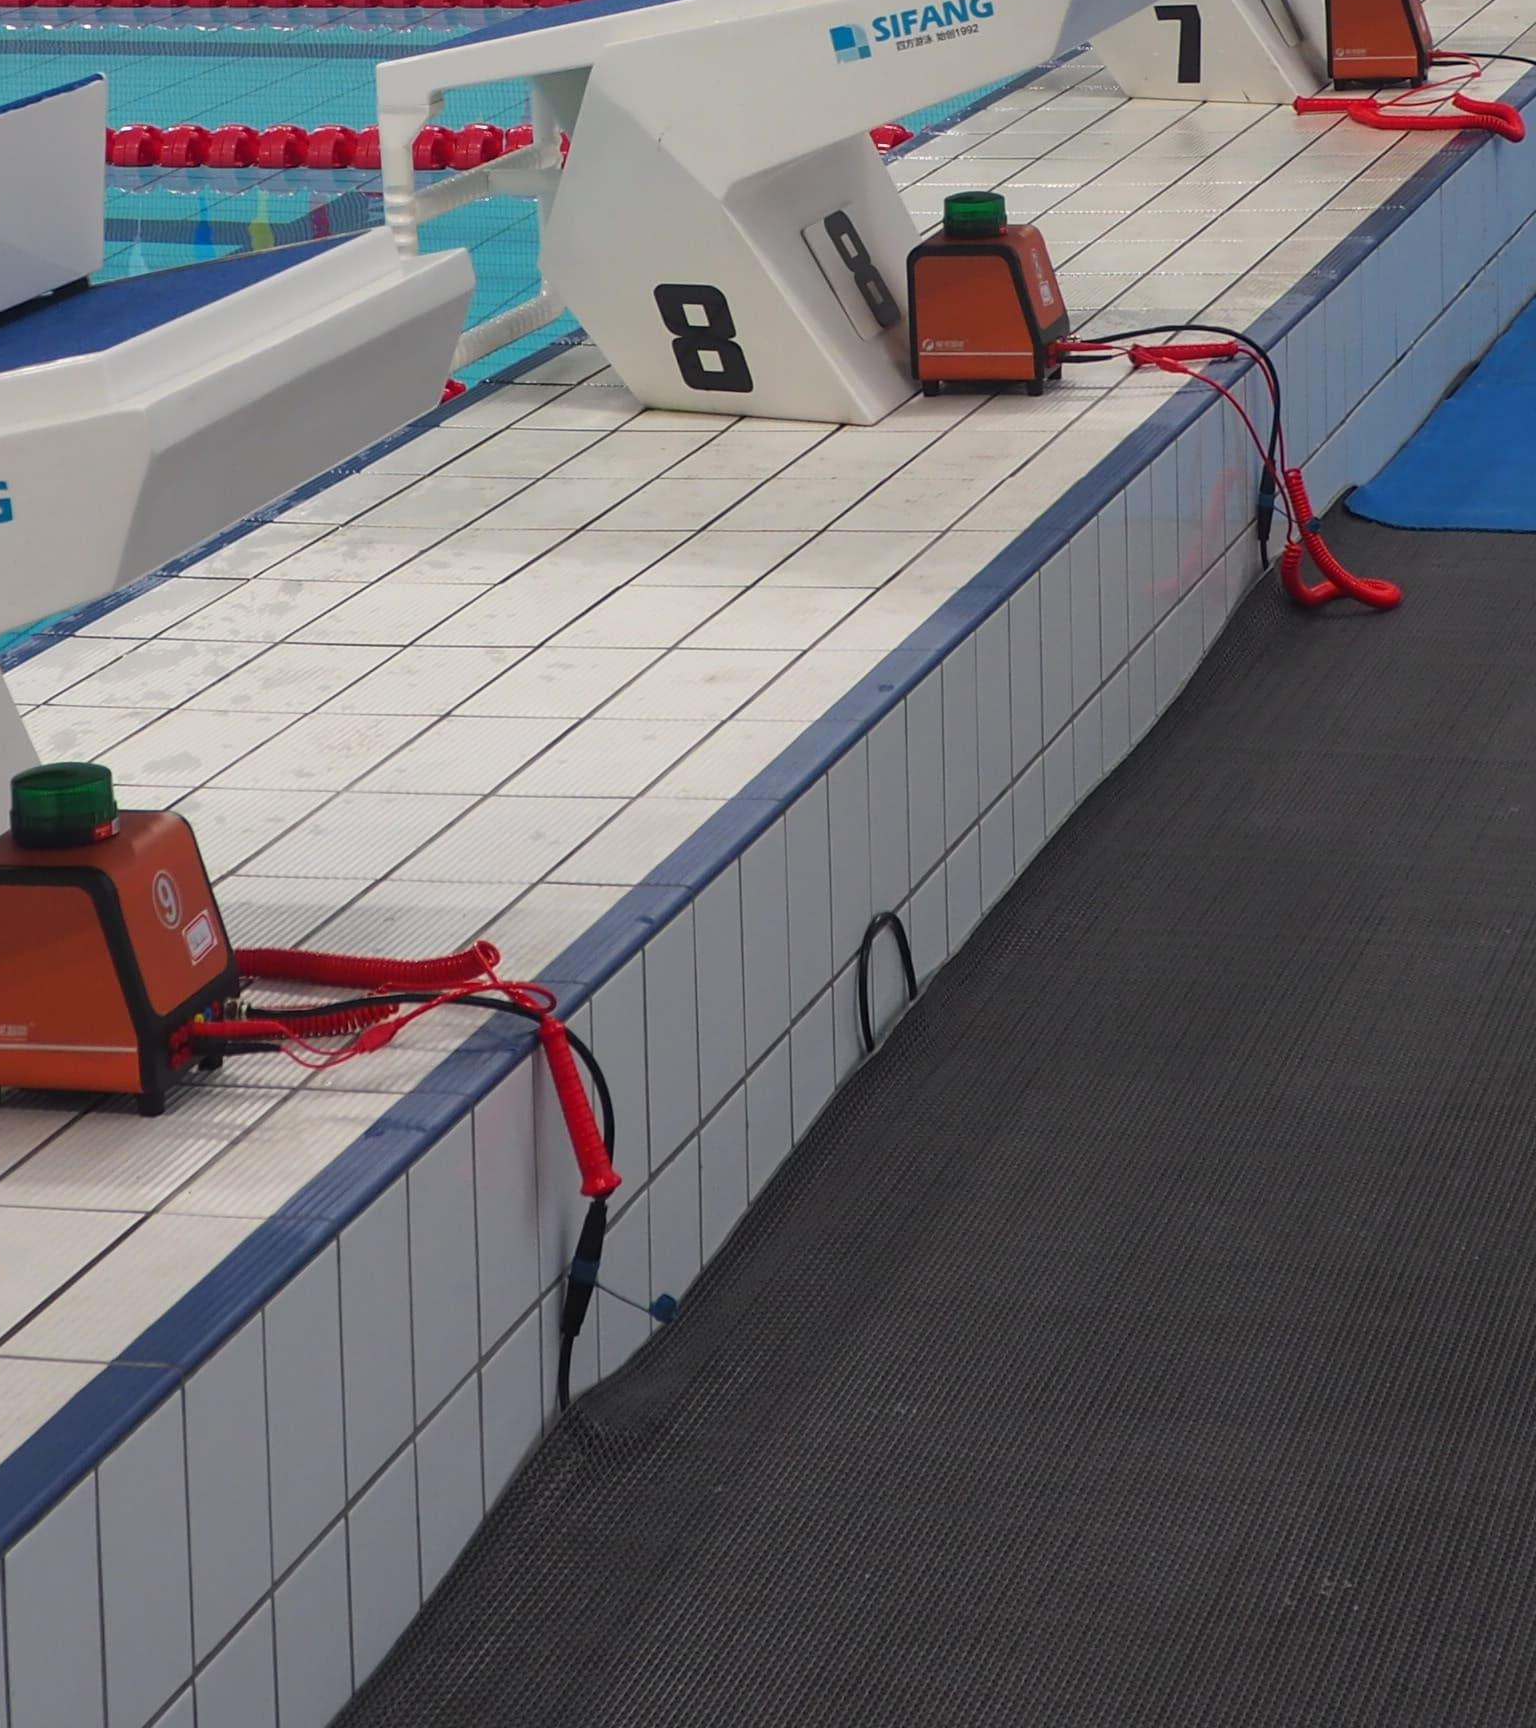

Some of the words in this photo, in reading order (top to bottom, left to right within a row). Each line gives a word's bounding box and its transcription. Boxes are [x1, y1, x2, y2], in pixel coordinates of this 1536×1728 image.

[1154, 5, 1202, 83] 7
[824, 210, 902, 328] 8
[653, 283, 754, 393] 8
[158, 876, 178, 926] 9
